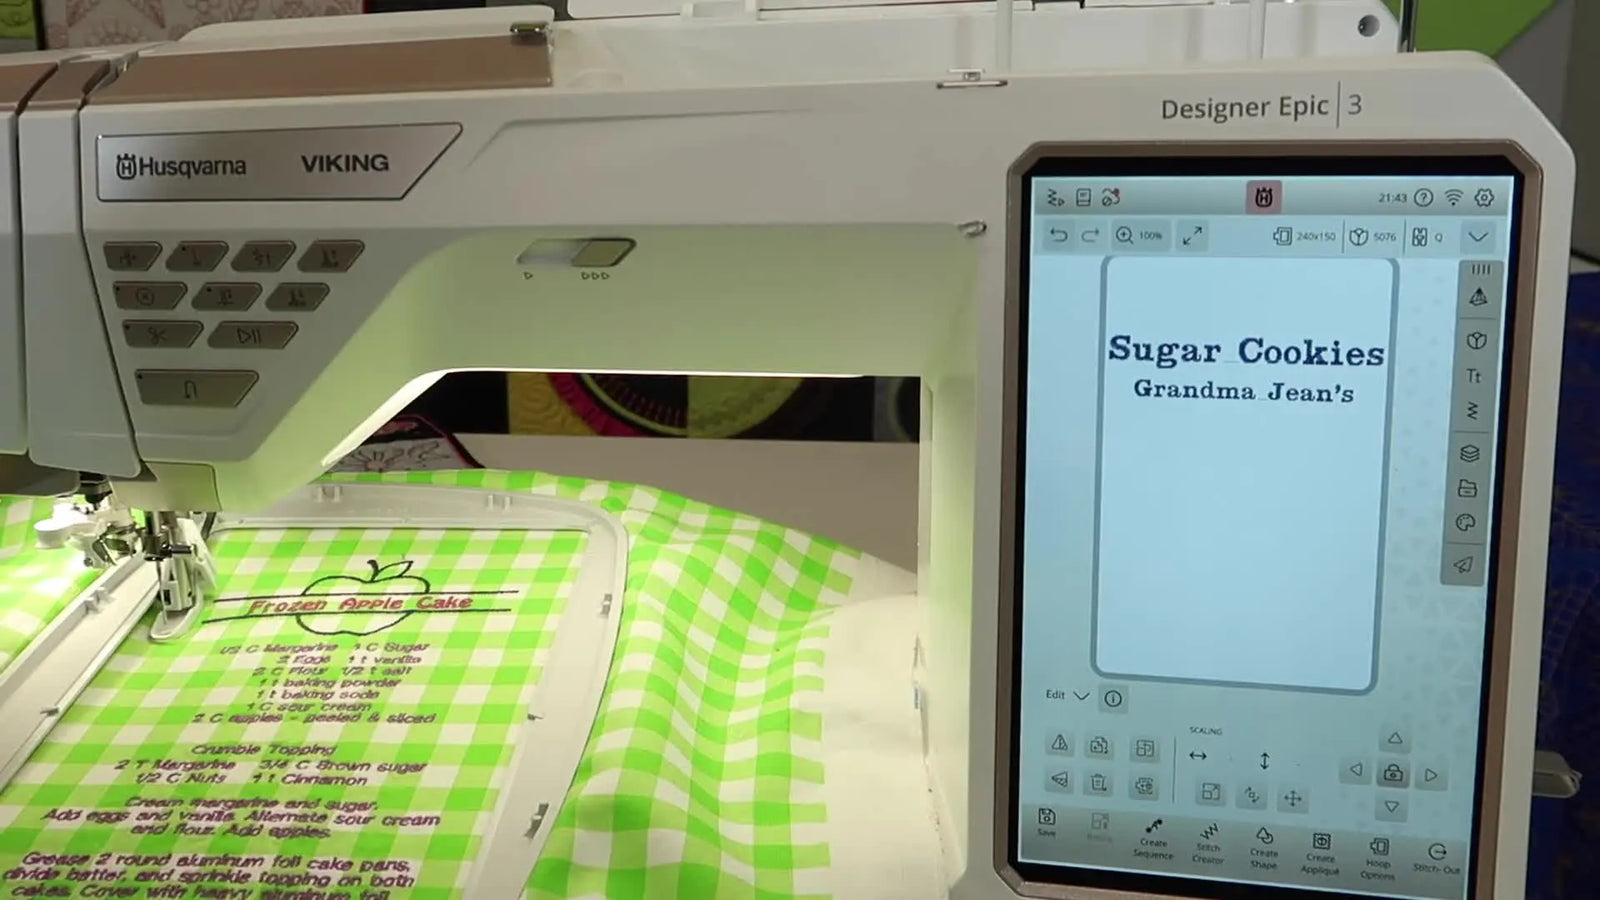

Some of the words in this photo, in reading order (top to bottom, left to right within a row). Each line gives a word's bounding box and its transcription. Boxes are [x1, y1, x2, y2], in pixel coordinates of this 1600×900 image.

[1161, 98, 1271, 123] Designer
[1278, 94, 1330, 120] Epic
[1347, 94, 1363, 114] 3
[139, 155, 247, 178] Husqvarna
[301, 154, 389, 172] VIKING
[1378, 192, 1408, 204] 21:43
[1373, 231, 1397, 242] 5076
[1108, 335, 1222, 369] Sugar
[1238, 337, 1385, 366] Cookies
[1133, 379, 1256, 400] Grandma
[1267, 382, 1354, 403] Jean's
[249, 599, 327, 613] Frozen
[338, 596, 403, 611] Apple
[416, 596, 473, 610] Cake
[1045, 689, 1066, 700] Edit
[191, 744, 261, 755] Crumble
[269, 744, 338, 756] Topping
[295, 760, 309, 770] C
[316, 759, 372, 771] Brown
[185, 773, 227, 783] Nuts
[281, 773, 368, 786] Cinnamon
[135, 810, 174, 821] and
[333, 813, 376, 825] sour
[382, 815, 441, 826] cream
[130, 824, 169, 835] and
[1140, 838, 1168, 848] Create
[1133, 849, 1175, 861] Sequence
[1250, 848, 1279, 859] Create
[1306, 852, 1336, 864] Create
[22, 851, 90, 866] Grease
[115, 853, 172, 866] round
[306, 857, 354, 871] cake
[1192, 854, 1225, 866] Creator
[1366, 858, 1392, 871] Hoop
[133, 869, 174, 882] and
[369, 873, 416, 888] both
